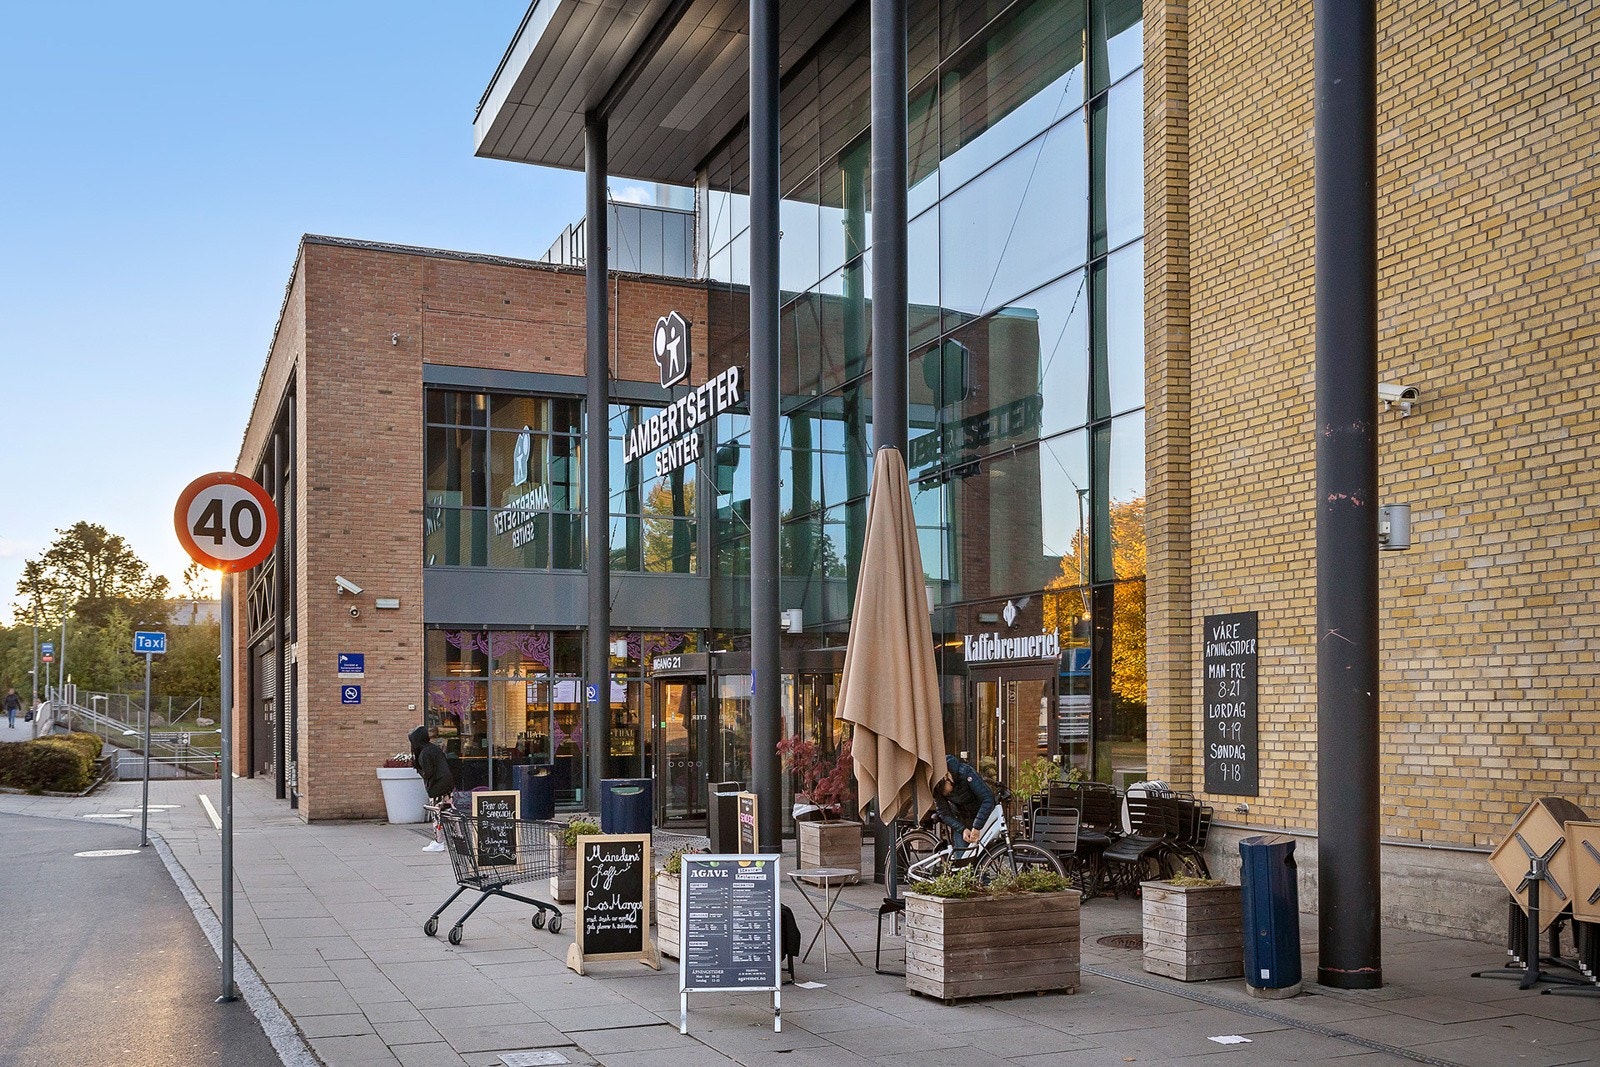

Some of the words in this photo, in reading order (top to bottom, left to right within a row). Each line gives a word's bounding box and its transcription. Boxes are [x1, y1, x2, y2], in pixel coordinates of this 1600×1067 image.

[622, 365, 741, 464] LAMBERTSETER
[655, 432, 700, 477] SENTER
[193, 499, 262, 547] 40
[1213, 621, 1240, 640] VÅRE
[138, 636, 164, 648] Taxi
[964, 627, 1061, 662] Kaffebrenneriet
[1206, 639, 1256, 657] ÅPNINGSTIDER
[672, 656, 681, 668] 21
[1208, 662, 1246, 679] MAN-FRE
[1209, 702, 1246, 718] LØRDAG
[1218, 722, 1242, 741] 9-19
[1210, 743, 1246, 761] SØNDAG
[1220, 762, 1242, 781] 9-18
[586, 845, 641, 862] Månedens
[690, 869, 729, 878] AGAVE
[584, 890, 608, 910] Los
[609, 893, 643, 922] Mangos
